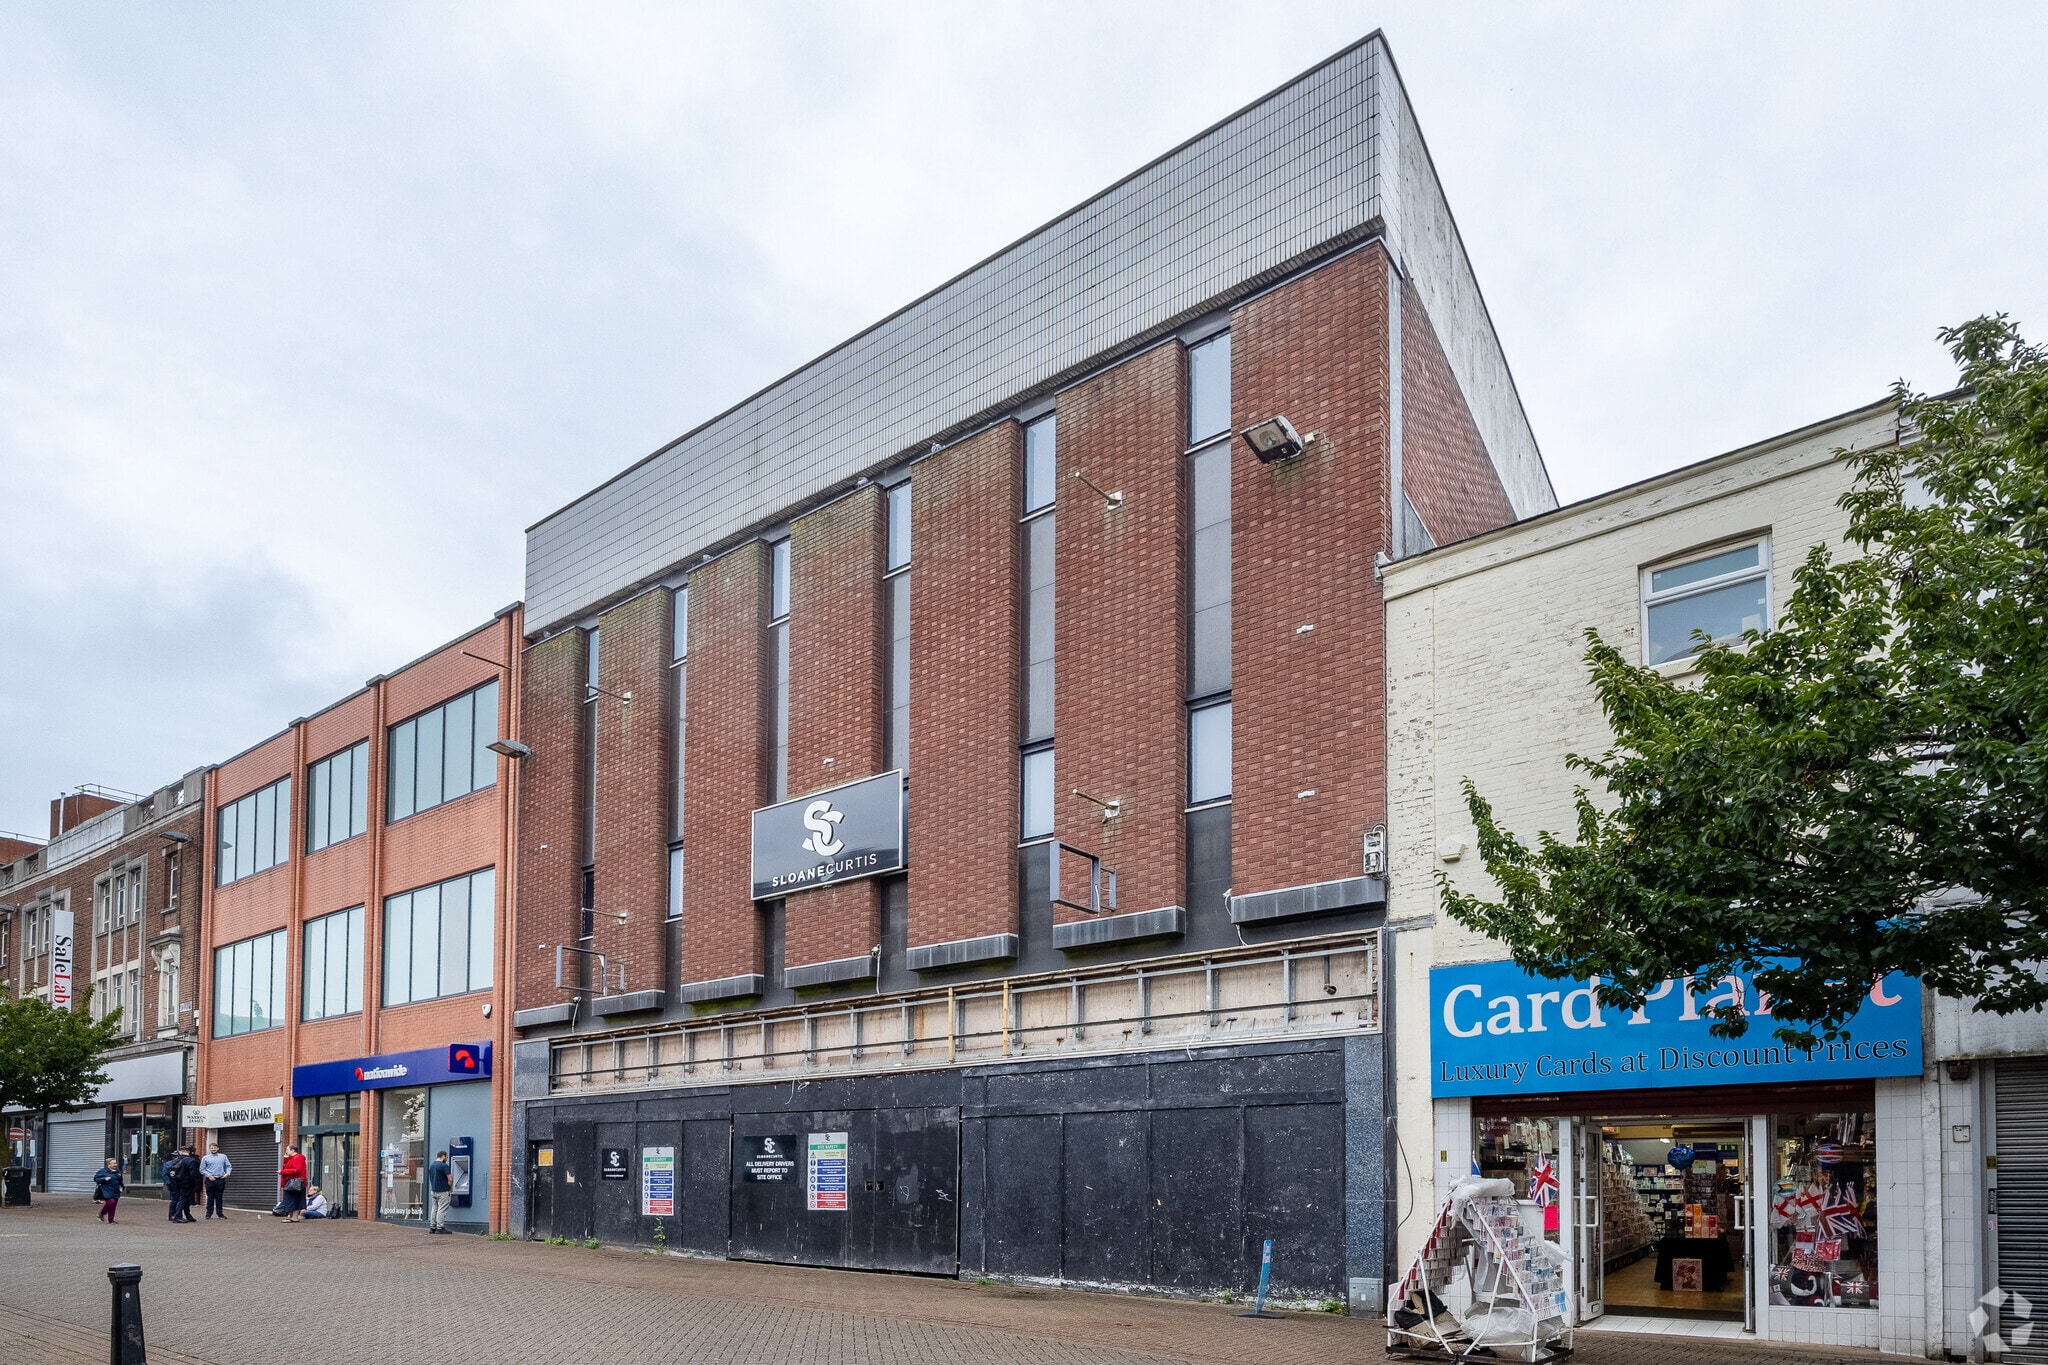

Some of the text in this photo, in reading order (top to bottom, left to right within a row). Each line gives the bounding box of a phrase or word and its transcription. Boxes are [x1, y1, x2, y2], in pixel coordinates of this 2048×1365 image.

[771, 853, 878, 888] SLOANECURTIS
[53, 934, 73, 1005] SaleLab
[1442, 974, 1607, 1038] Card
[363, 1064, 408, 1081] nationwide
[1440, 1037, 1908, 1084] Luxury Cards at Discount Prices
[222, 1109, 250, 1122] WARREN
[250, 1106, 272, 1121] JAMES
[384, 1206, 396, 1216] good
